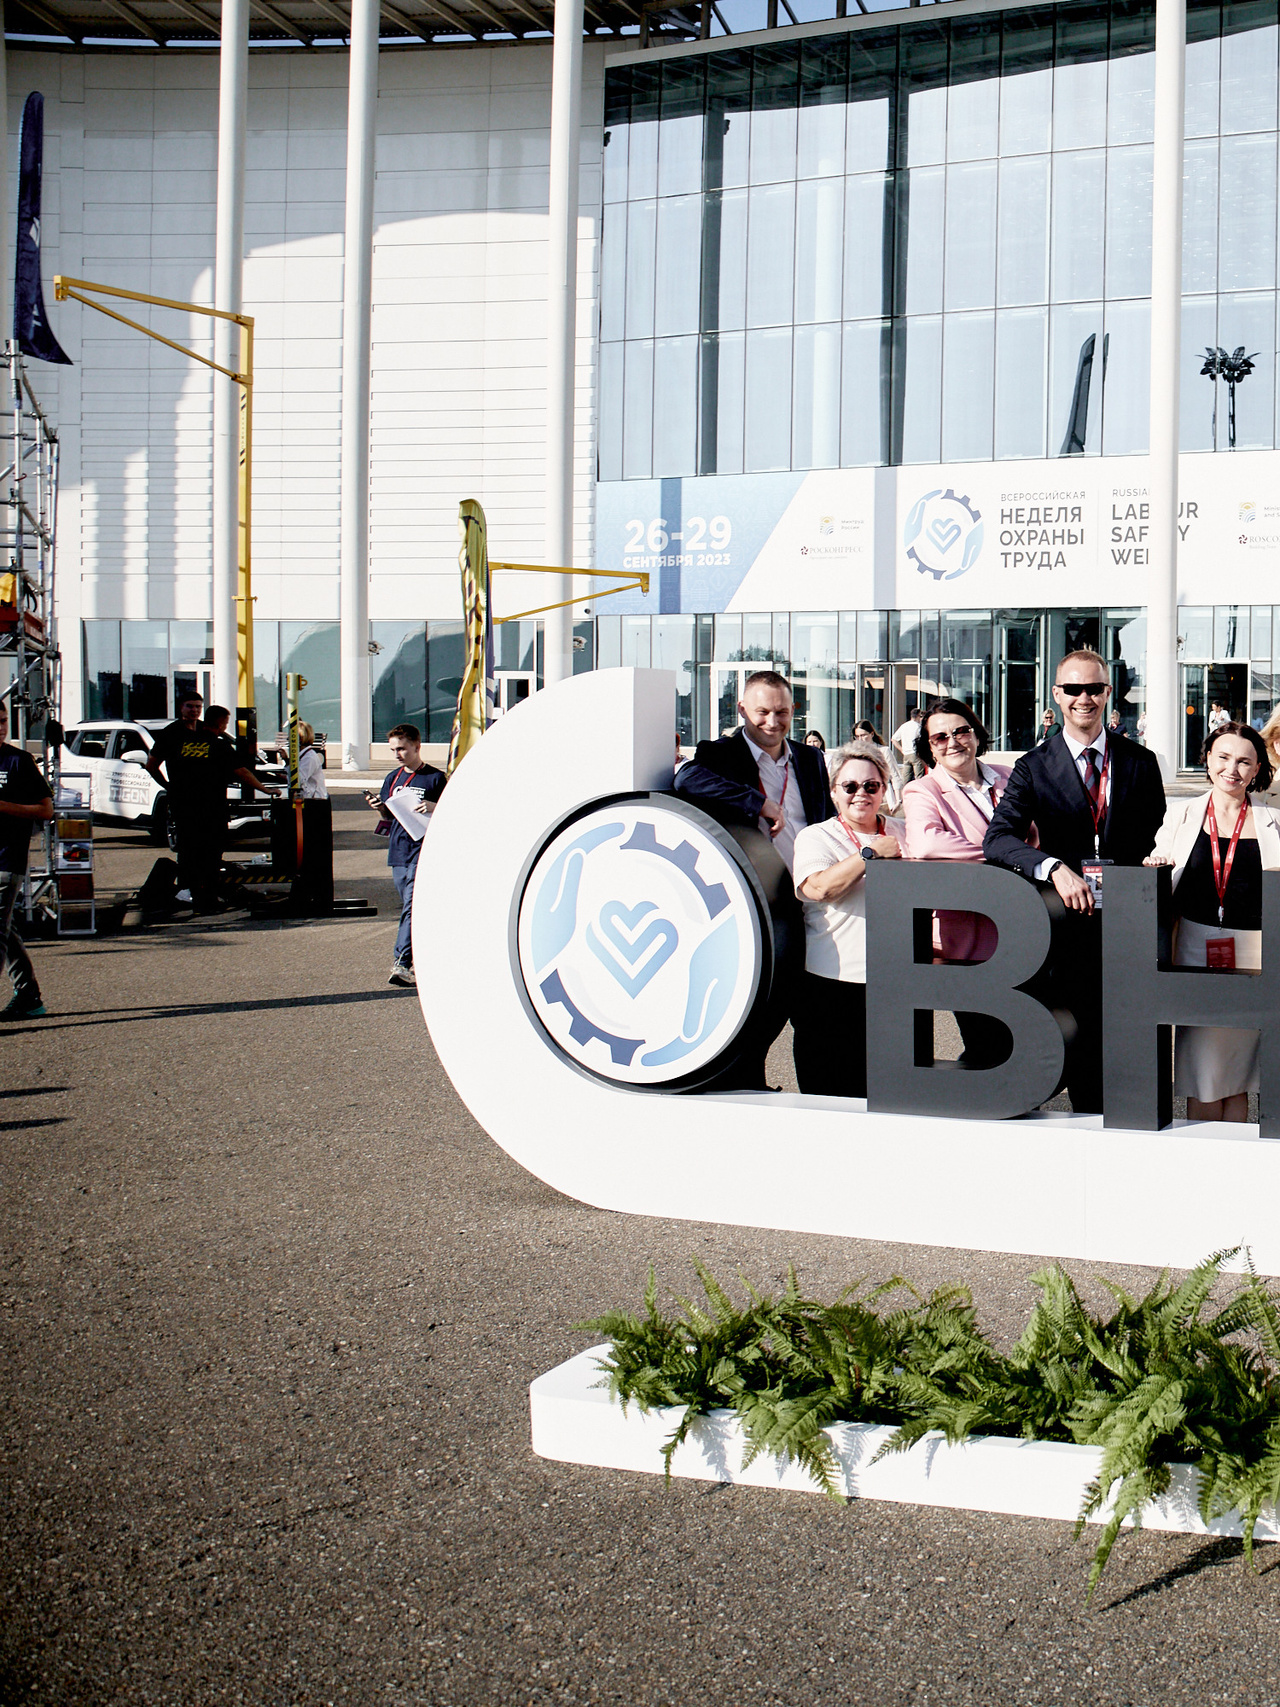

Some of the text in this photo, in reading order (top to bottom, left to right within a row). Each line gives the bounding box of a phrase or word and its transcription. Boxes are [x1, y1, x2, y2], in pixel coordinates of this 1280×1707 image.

[1001, 490, 1085, 501] ВСЕРОССИЙСКАЯ
[1112, 488, 1150, 497] RUSSIA
[1000, 506, 1081, 526] НЕДЕЛЯ
[624, 515, 732, 553] 26-29
[1000, 529, 1084, 546] ОХРАНЫ
[1111, 524, 1190, 543] SAFY
[810, 546, 863, 554] РОСКОНГРЕСС
[623, 553, 731, 569] СЕНТЯБРЯ 2023
[1000, 551, 1067, 570] ТРУДА
